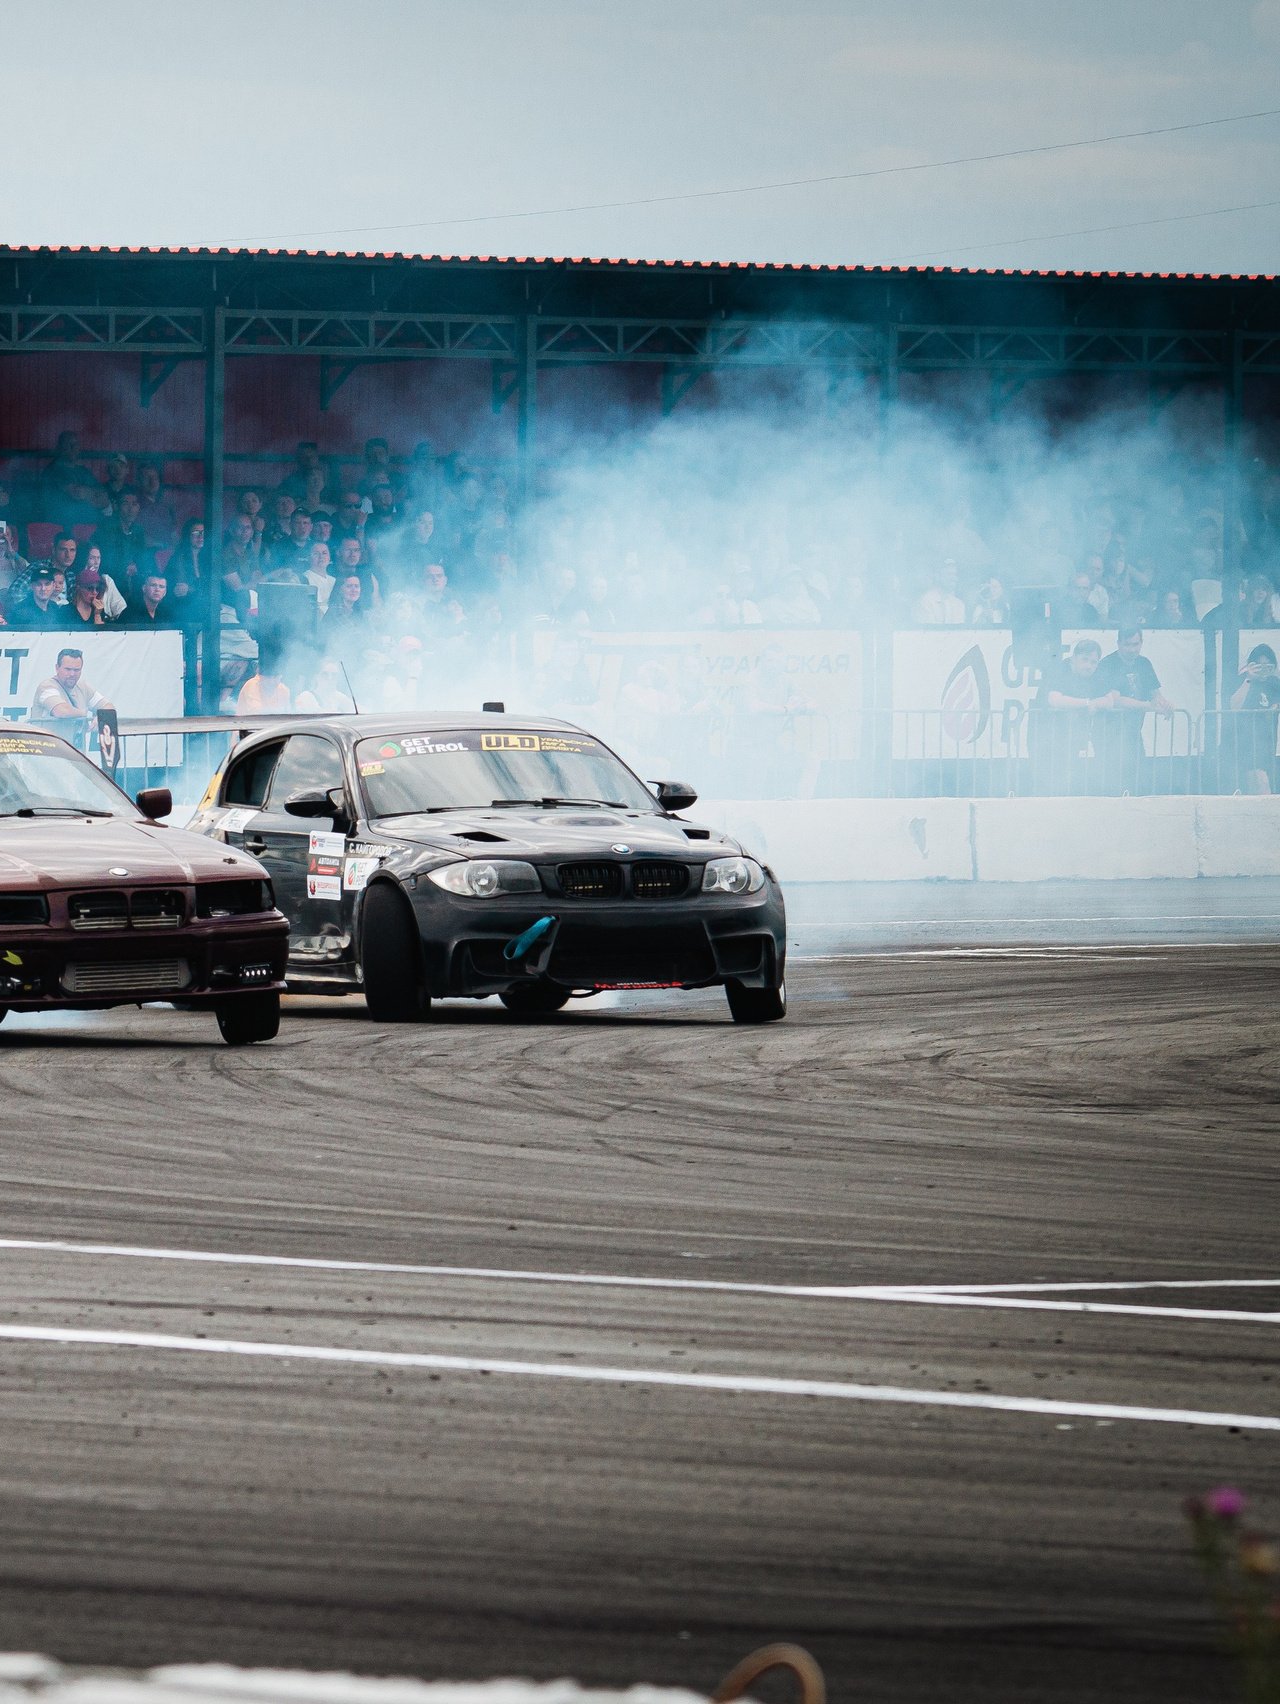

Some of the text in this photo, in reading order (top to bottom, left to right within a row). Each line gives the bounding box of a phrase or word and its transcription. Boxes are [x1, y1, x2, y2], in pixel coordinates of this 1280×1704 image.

[705, 654, 851, 675] УРАСКАЯ
[401, 736, 431, 747] GET
[406, 741, 469, 755] PETROL
[484, 735, 537, 750] ULD
[540, 737, 596, 747] УРАЛЬСКАЯ
